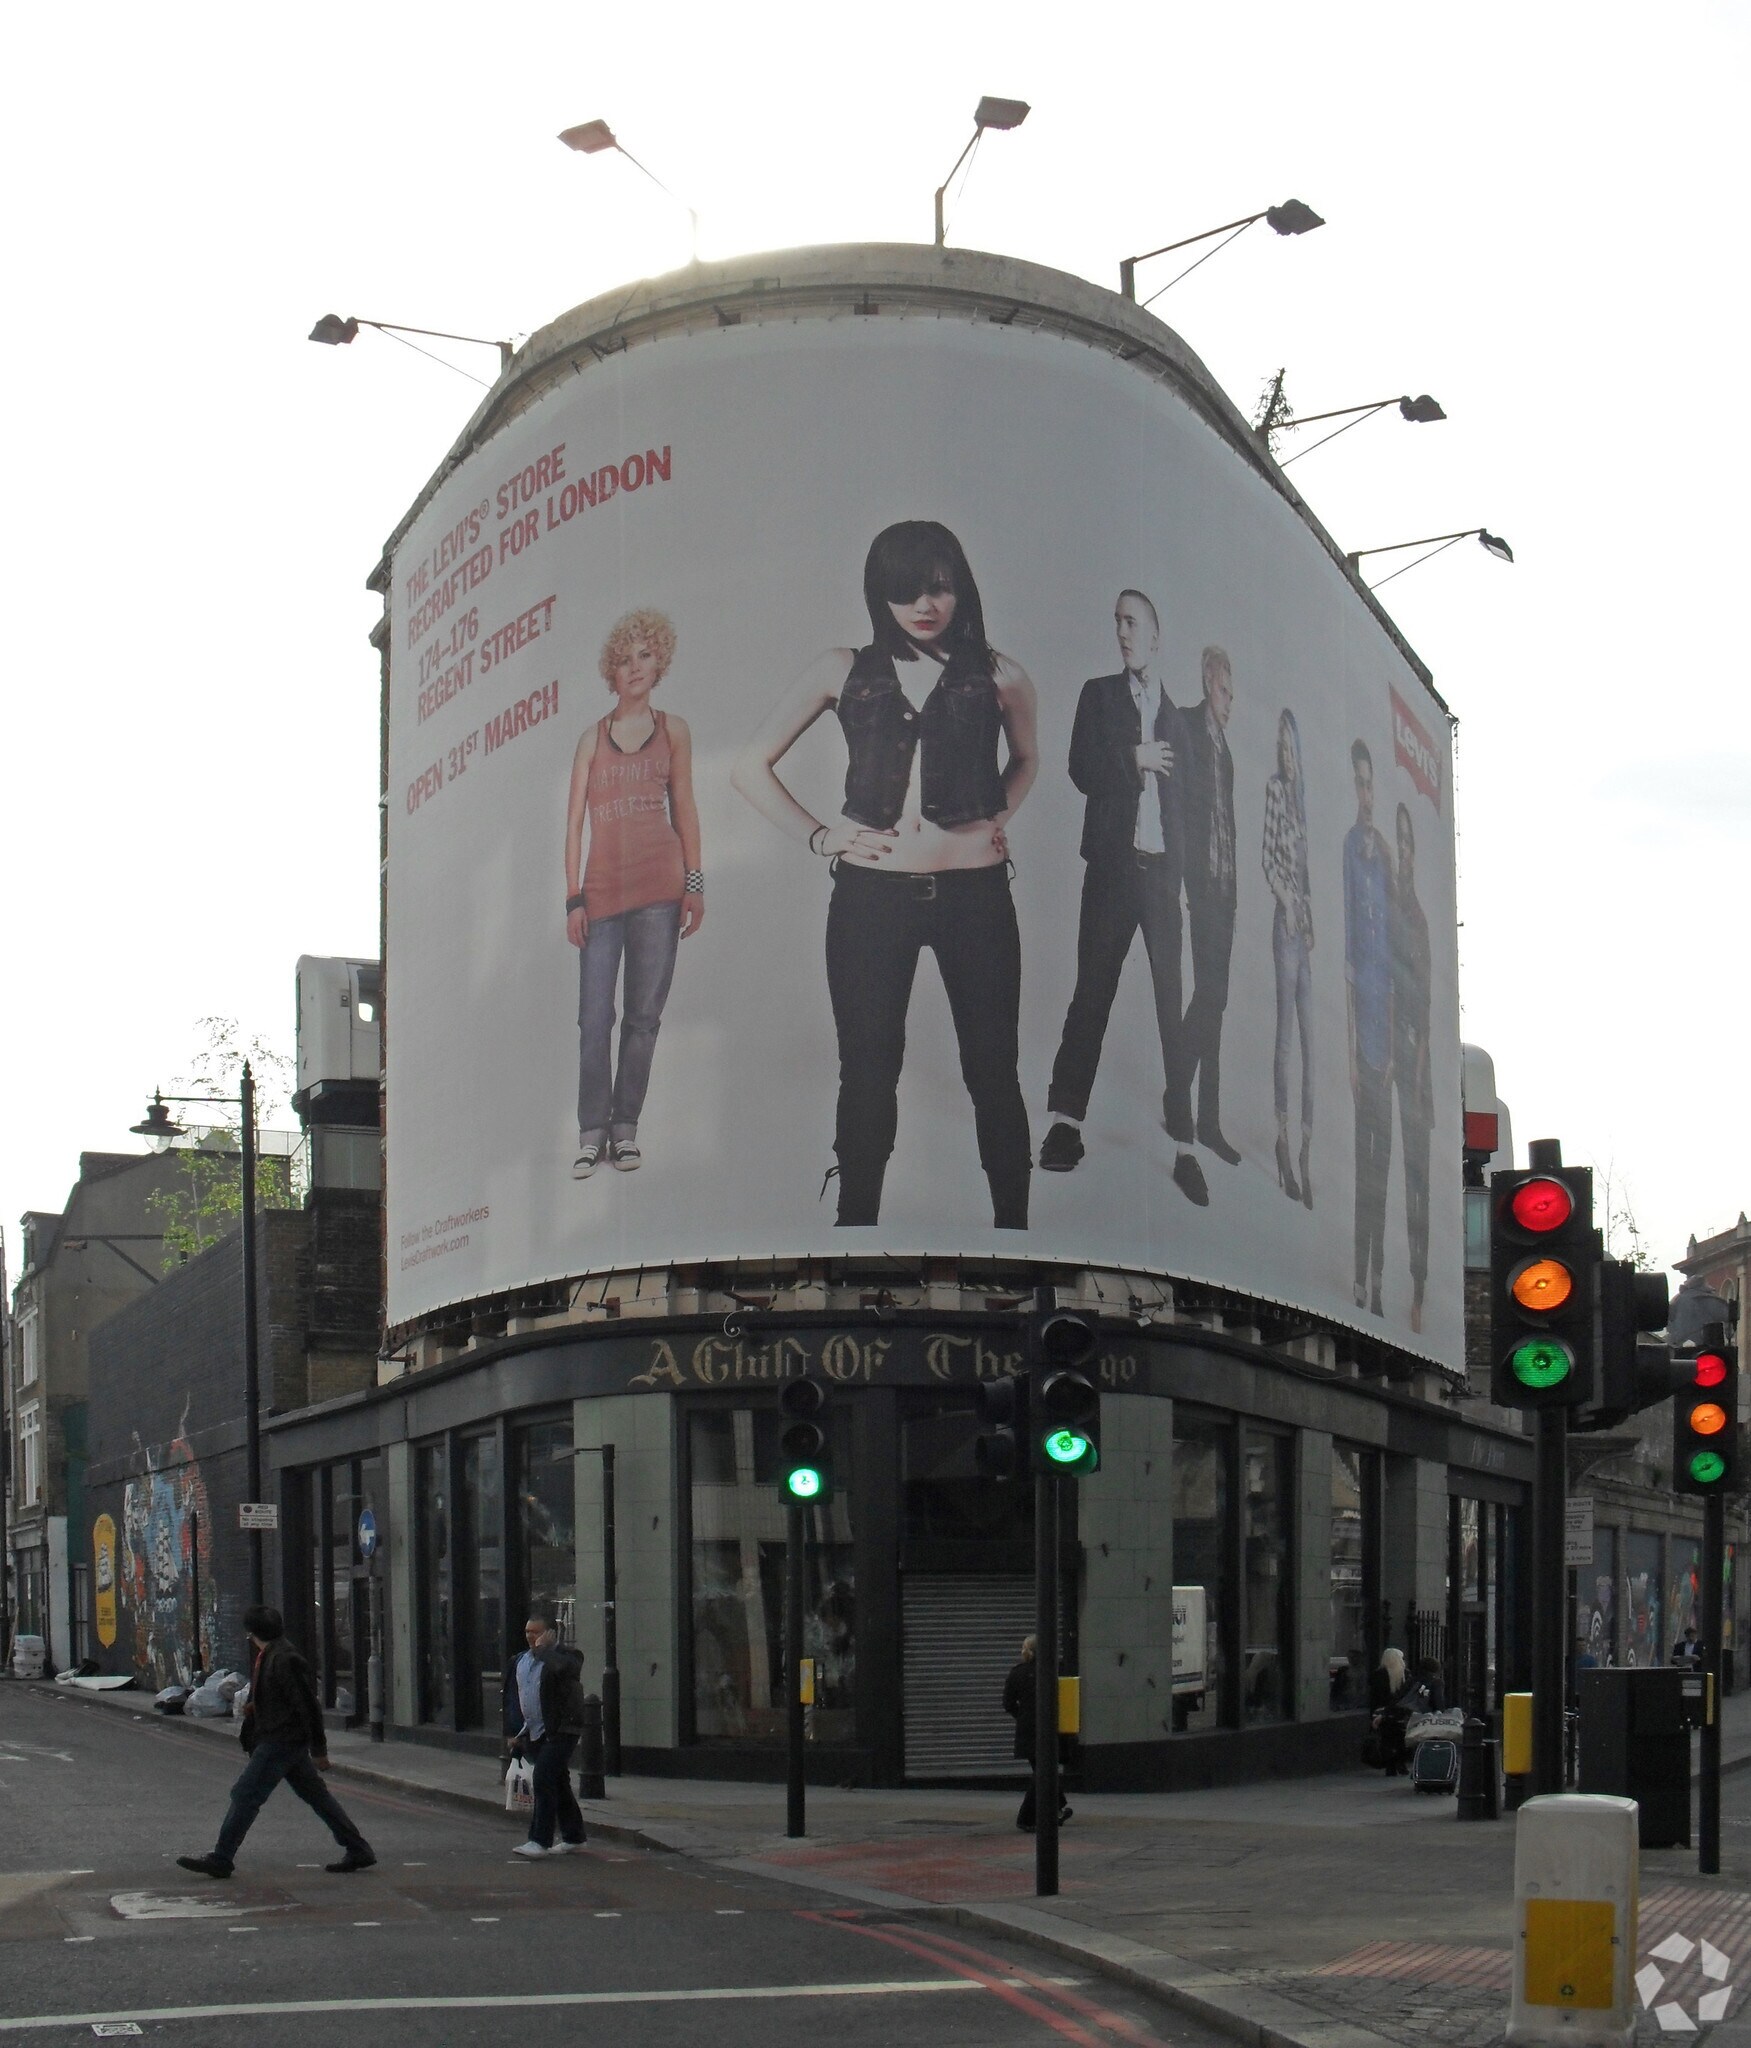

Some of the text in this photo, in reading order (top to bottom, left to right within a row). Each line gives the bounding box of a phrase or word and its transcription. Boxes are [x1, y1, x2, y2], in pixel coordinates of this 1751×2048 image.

[406, 558, 429, 609] THE
[496, 443, 566, 520] STORE
[408, 445, 671, 650] RECRAFTED FOR LONDON
[417, 594, 557, 727] REGENT STREET
[406, 680, 559, 815] OPEN 31ST MARCH
[435, 1206, 489, 1235] Craftworkers
[627, 1338, 685, 1385] A
[821, 1334, 892, 1381] Of
[920, 1334, 1024, 1380] The
